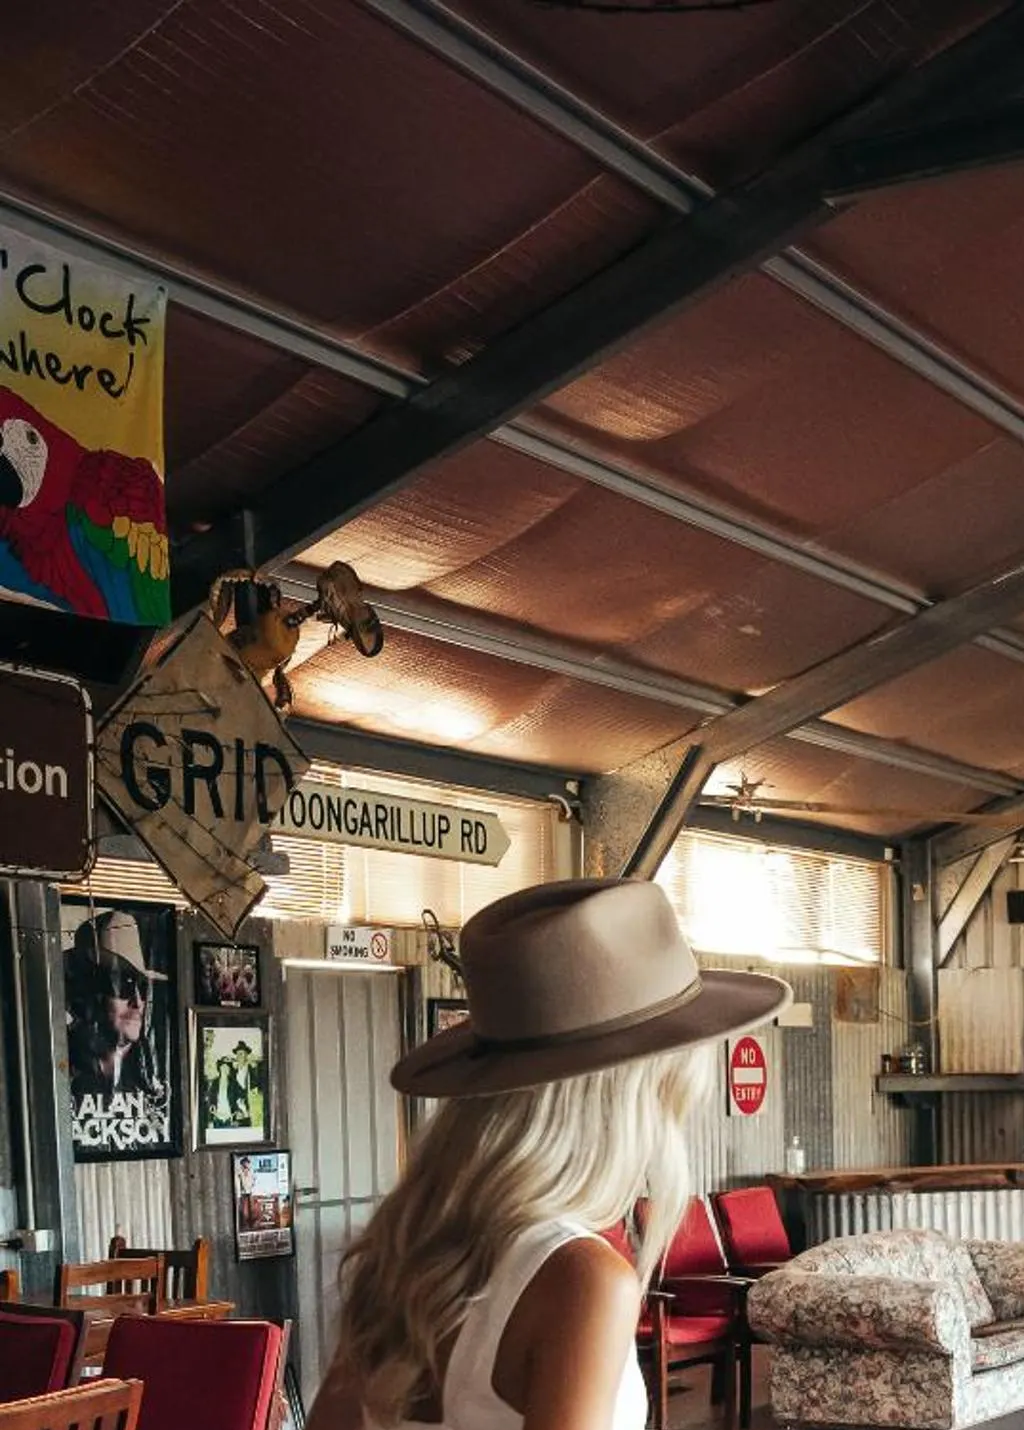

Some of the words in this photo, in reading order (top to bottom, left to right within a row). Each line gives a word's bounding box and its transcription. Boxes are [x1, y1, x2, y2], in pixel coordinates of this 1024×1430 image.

[120, 722, 294, 824] GRID
[461, 819, 487, 855] RD
[343, 930, 356, 942] NO
[330, 945, 369, 958] SMOKING
[741, 1047, 756, 1064] NO
[78, 1090, 144, 1119] ALAN
[735, 1086, 762, 1101] ENTRY
[72, 1118, 170, 1148] ACKSON
